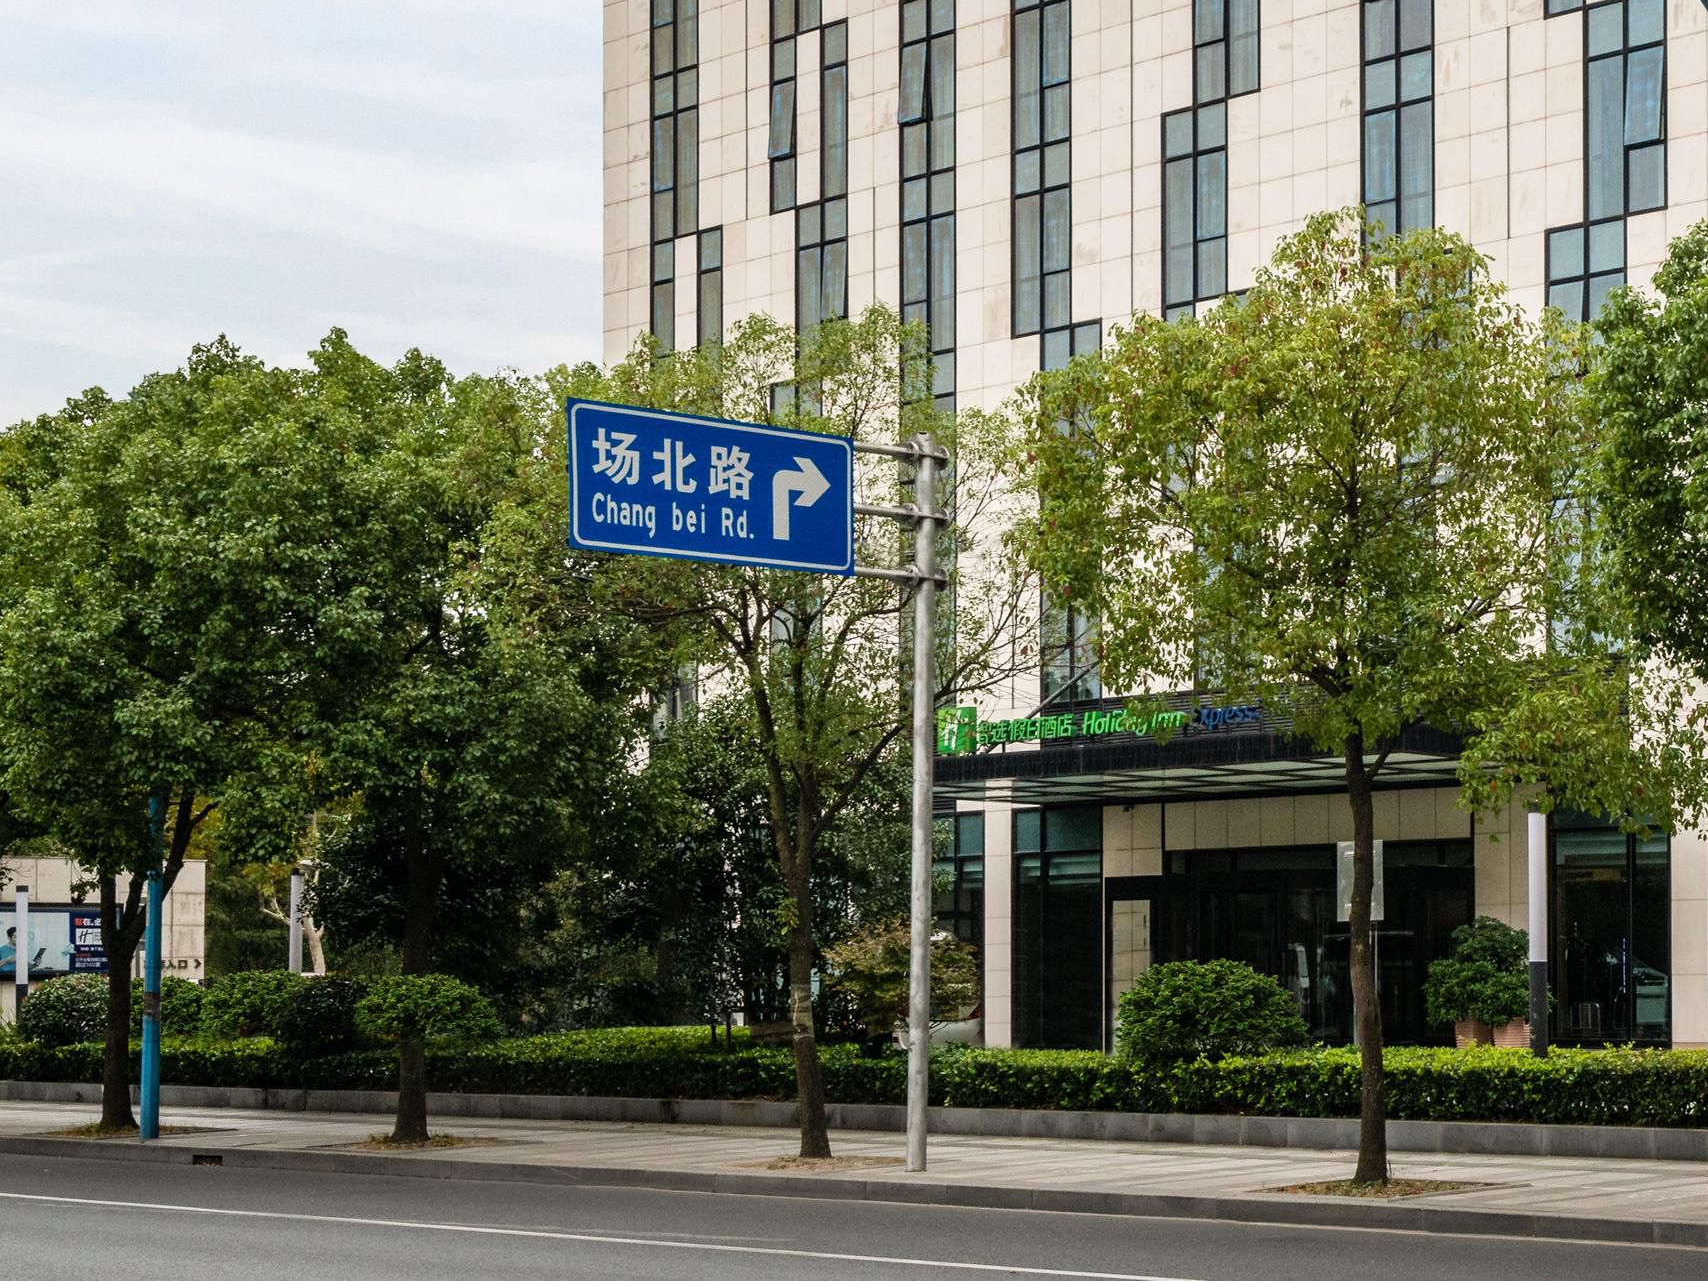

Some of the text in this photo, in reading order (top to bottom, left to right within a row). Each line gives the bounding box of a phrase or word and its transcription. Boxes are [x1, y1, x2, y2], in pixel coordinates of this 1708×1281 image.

[592, 428, 754, 501] 场北路
[592, 492, 755, 539] Chang bei Rd.
[1193, 704, 1260, 733] xpress
